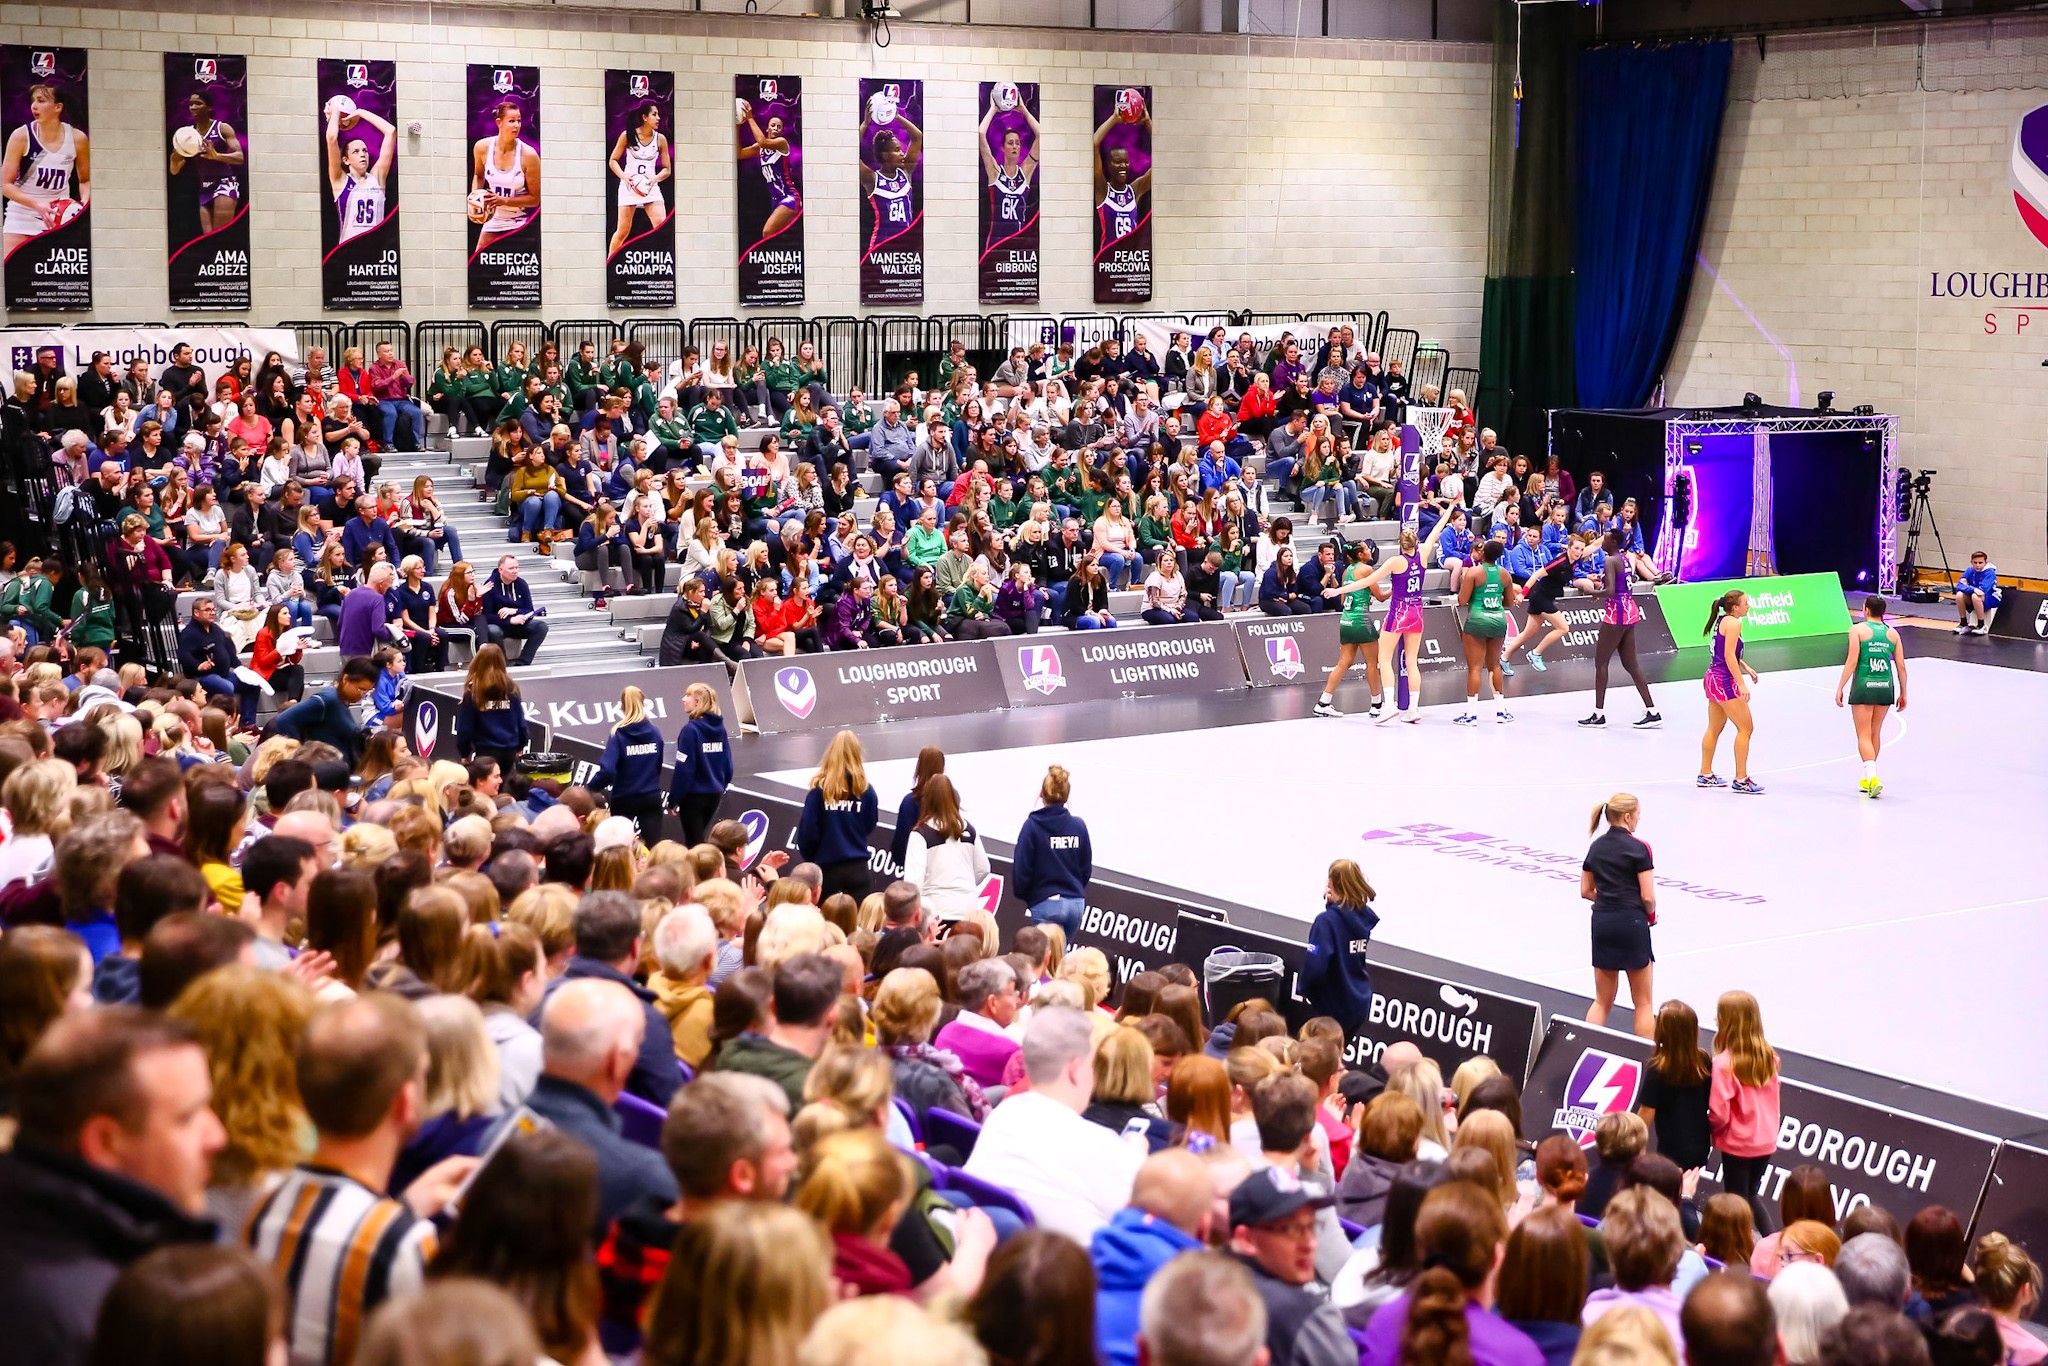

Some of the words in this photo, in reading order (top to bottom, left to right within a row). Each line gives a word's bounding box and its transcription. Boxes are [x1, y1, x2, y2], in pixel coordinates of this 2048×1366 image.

[637, 164, 646, 174] C
[889, 201, 907, 222] GA
[1001, 197, 1020, 220] GK
[47, 248, 88, 262] JADE
[214, 250, 248, 264] AMA
[379, 250, 397, 263] JO
[480, 253, 539, 265] REBECCA
[625, 251, 673, 264] SOPHIA
[749, 251, 802, 264] HANNAH
[870, 252, 922, 264] VANESSA
[1010, 250, 1037, 262] ELLA
[1114, 250, 1150, 262] PEACE
[35, 263, 88, 275] CLARKE
[198, 264, 248, 276] AGBEZE
[349, 264, 397, 276] HARTEN
[503, 265, 539, 276] JAMES
[616, 264, 673, 275] CANDAPPA
[761, 264, 802, 274] JOSEPH
[881, 264, 921, 275] WALKER
[996, 263, 1037, 273] GIBBONS
[1099, 262, 1150, 273] PROSCOVIA
[1747, 609, 1791, 627] Health
[1247, 622, 1289, 637] FOLLOW
[1290, 622, 1306, 633] US
[1081, 638, 1215, 663] LOUGHBOROUGH
[838, 656, 977, 684] LOUGHBOROUGH
[1110, 662, 1200, 684] LIGHTNING
[886, 683, 941, 704] SPORT
[626, 743, 657, 756] MADDIE
[856, 801, 862, 813] T
[1050, 836, 1079, 849] FREYA
